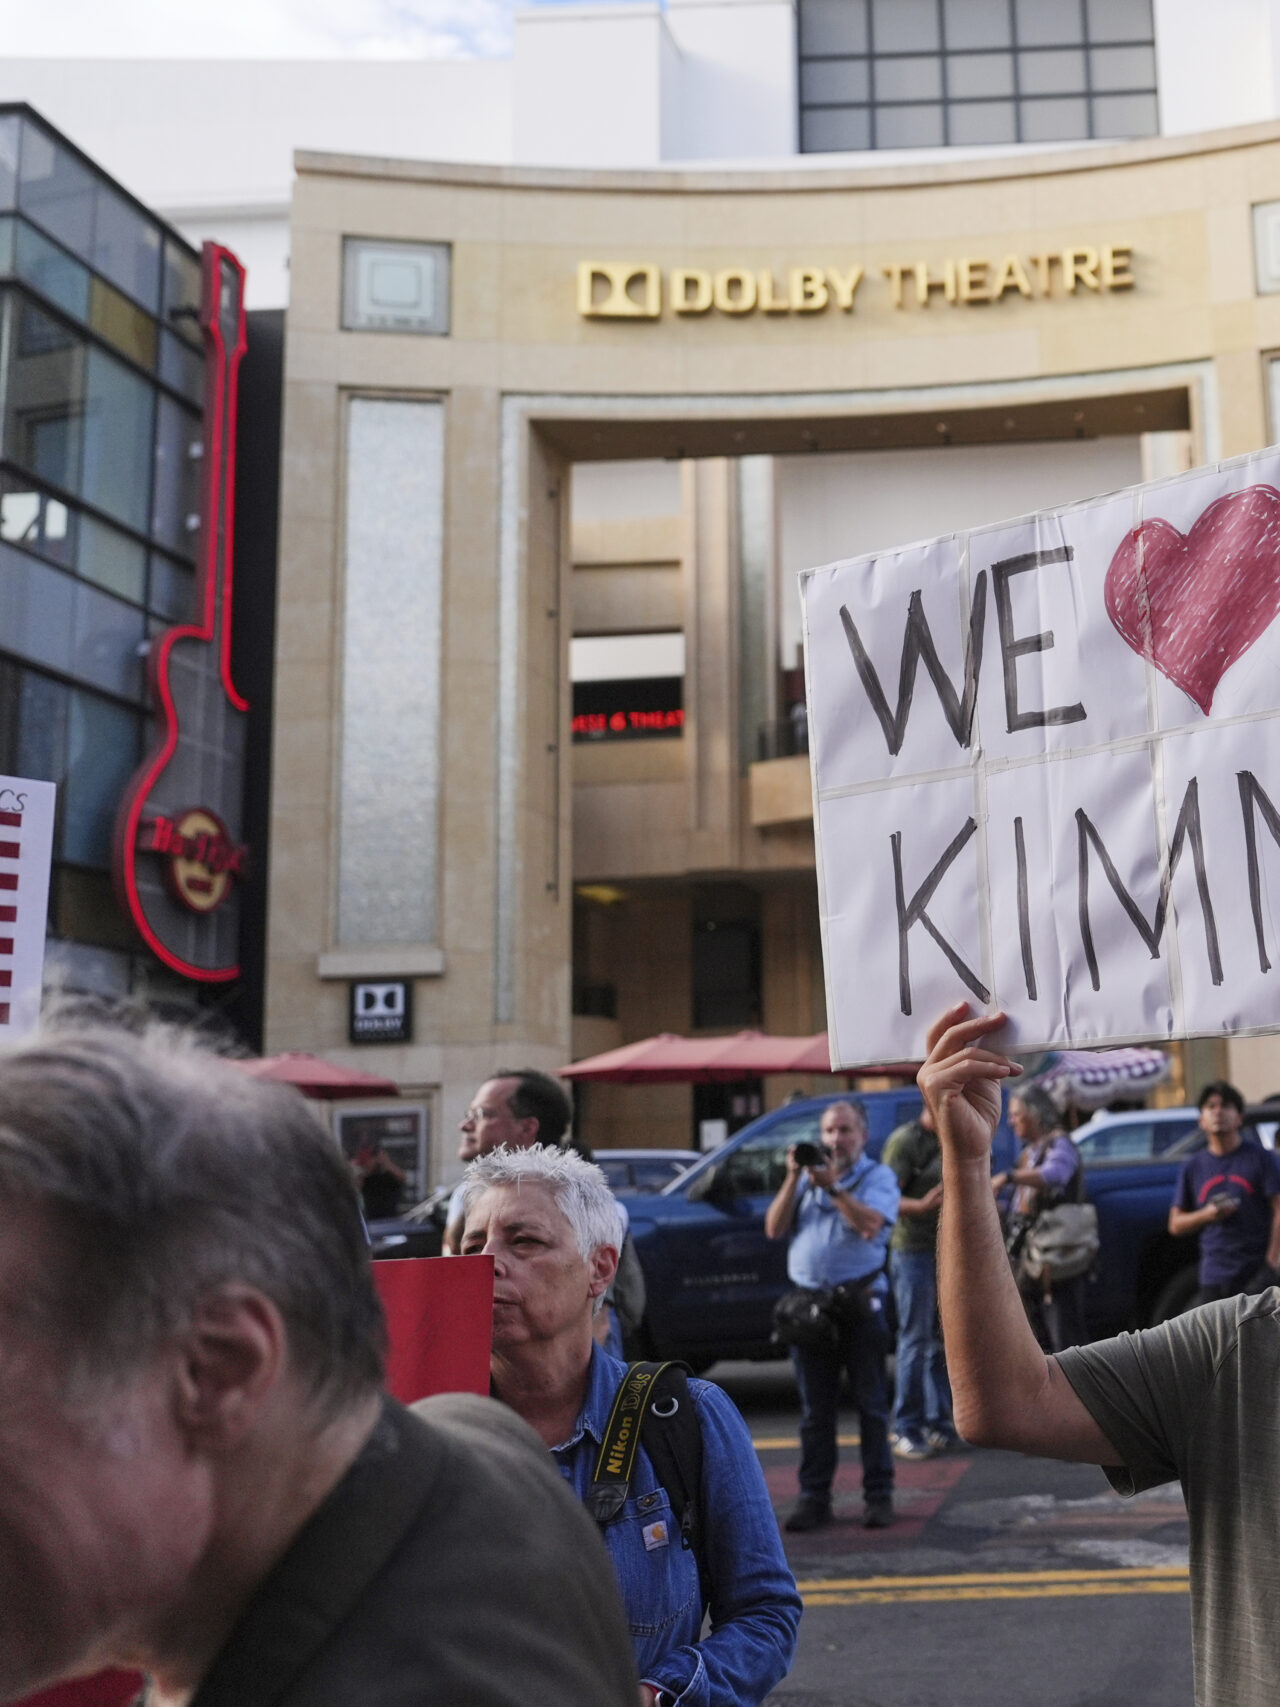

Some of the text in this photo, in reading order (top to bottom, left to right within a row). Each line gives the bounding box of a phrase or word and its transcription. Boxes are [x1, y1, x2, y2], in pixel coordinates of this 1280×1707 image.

[668, 245, 1136, 314] DOLBY THEATRE
[840, 545, 1087, 756] WE
[606, 1416, 633, 1474] Nikon
